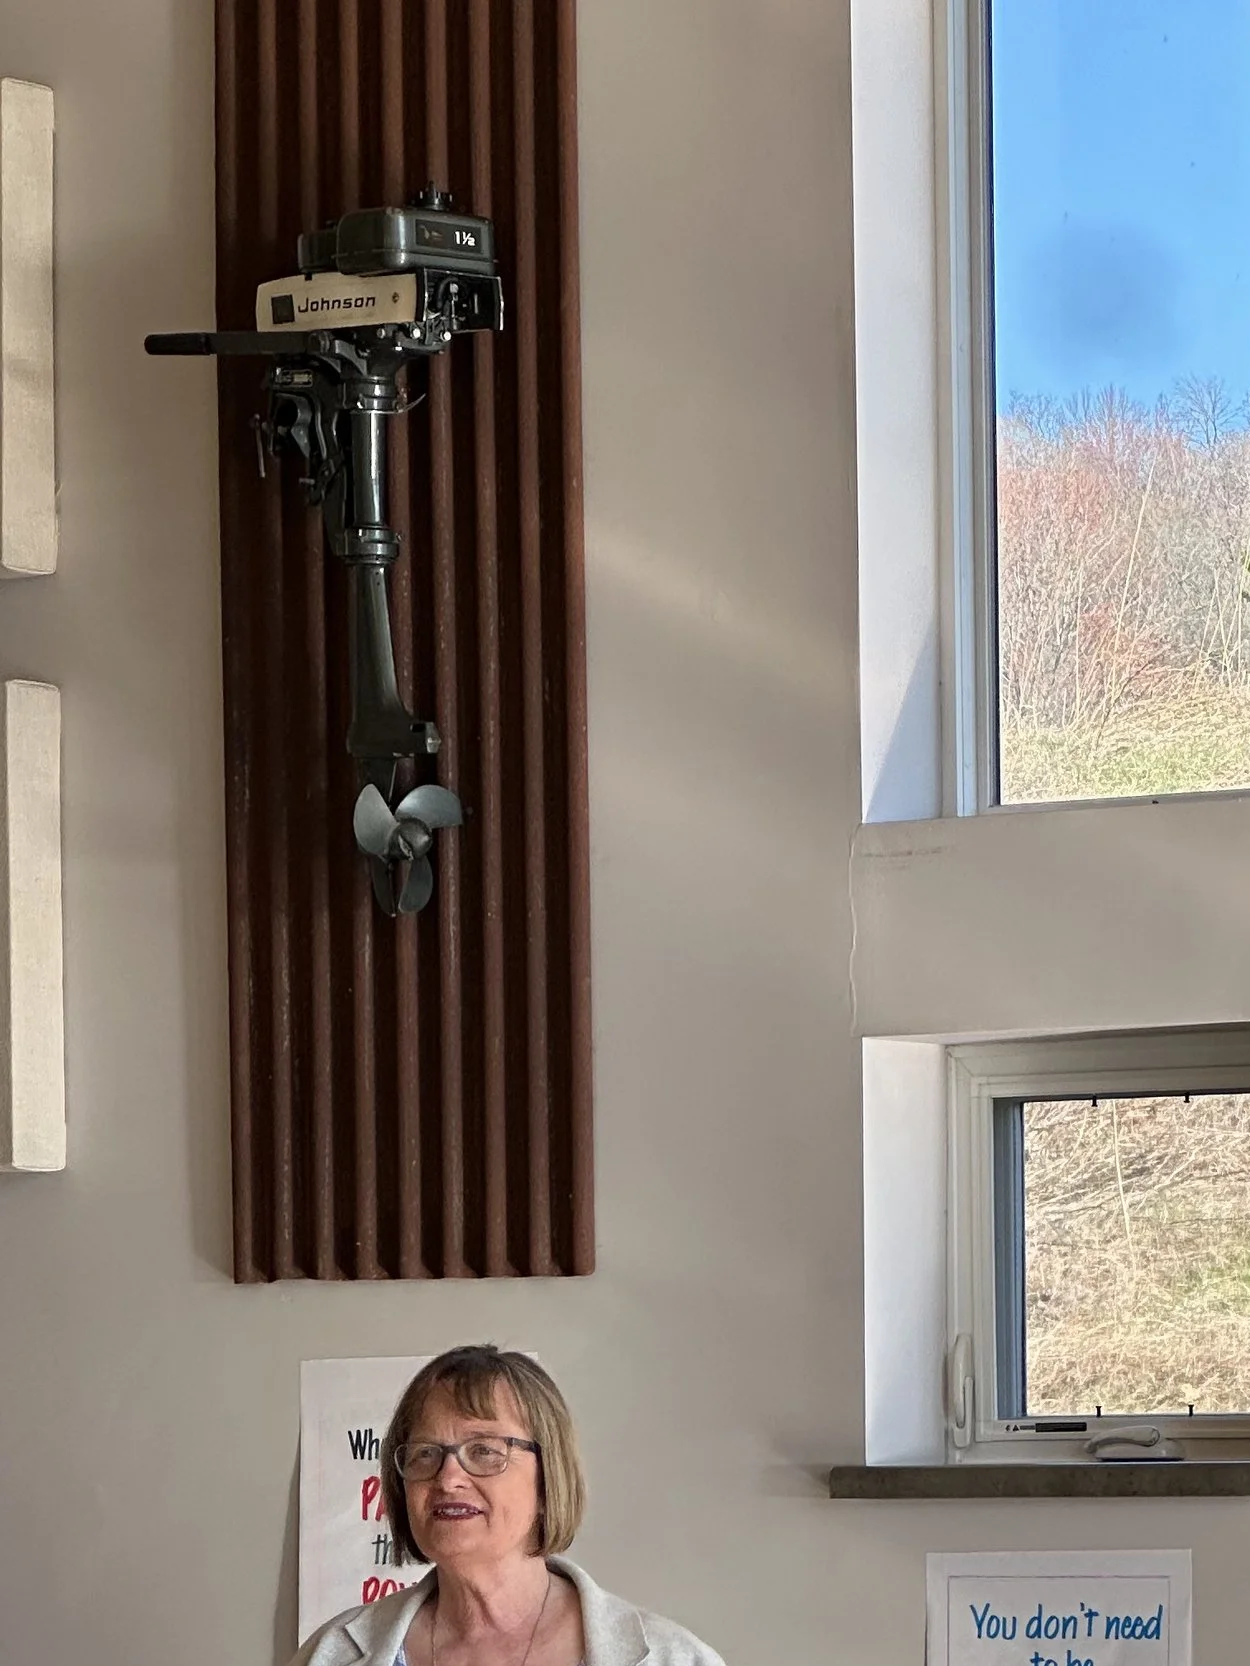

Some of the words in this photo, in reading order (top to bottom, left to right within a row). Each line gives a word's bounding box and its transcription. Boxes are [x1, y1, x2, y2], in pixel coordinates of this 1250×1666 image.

[297, 296, 376, 313] Johnson
[348, 1428, 380, 1461] Wh
[969, 1603, 1017, 1640] You
[1025, 1602, 1099, 1640] don't
[1105, 1603, 1164, 1640] need
